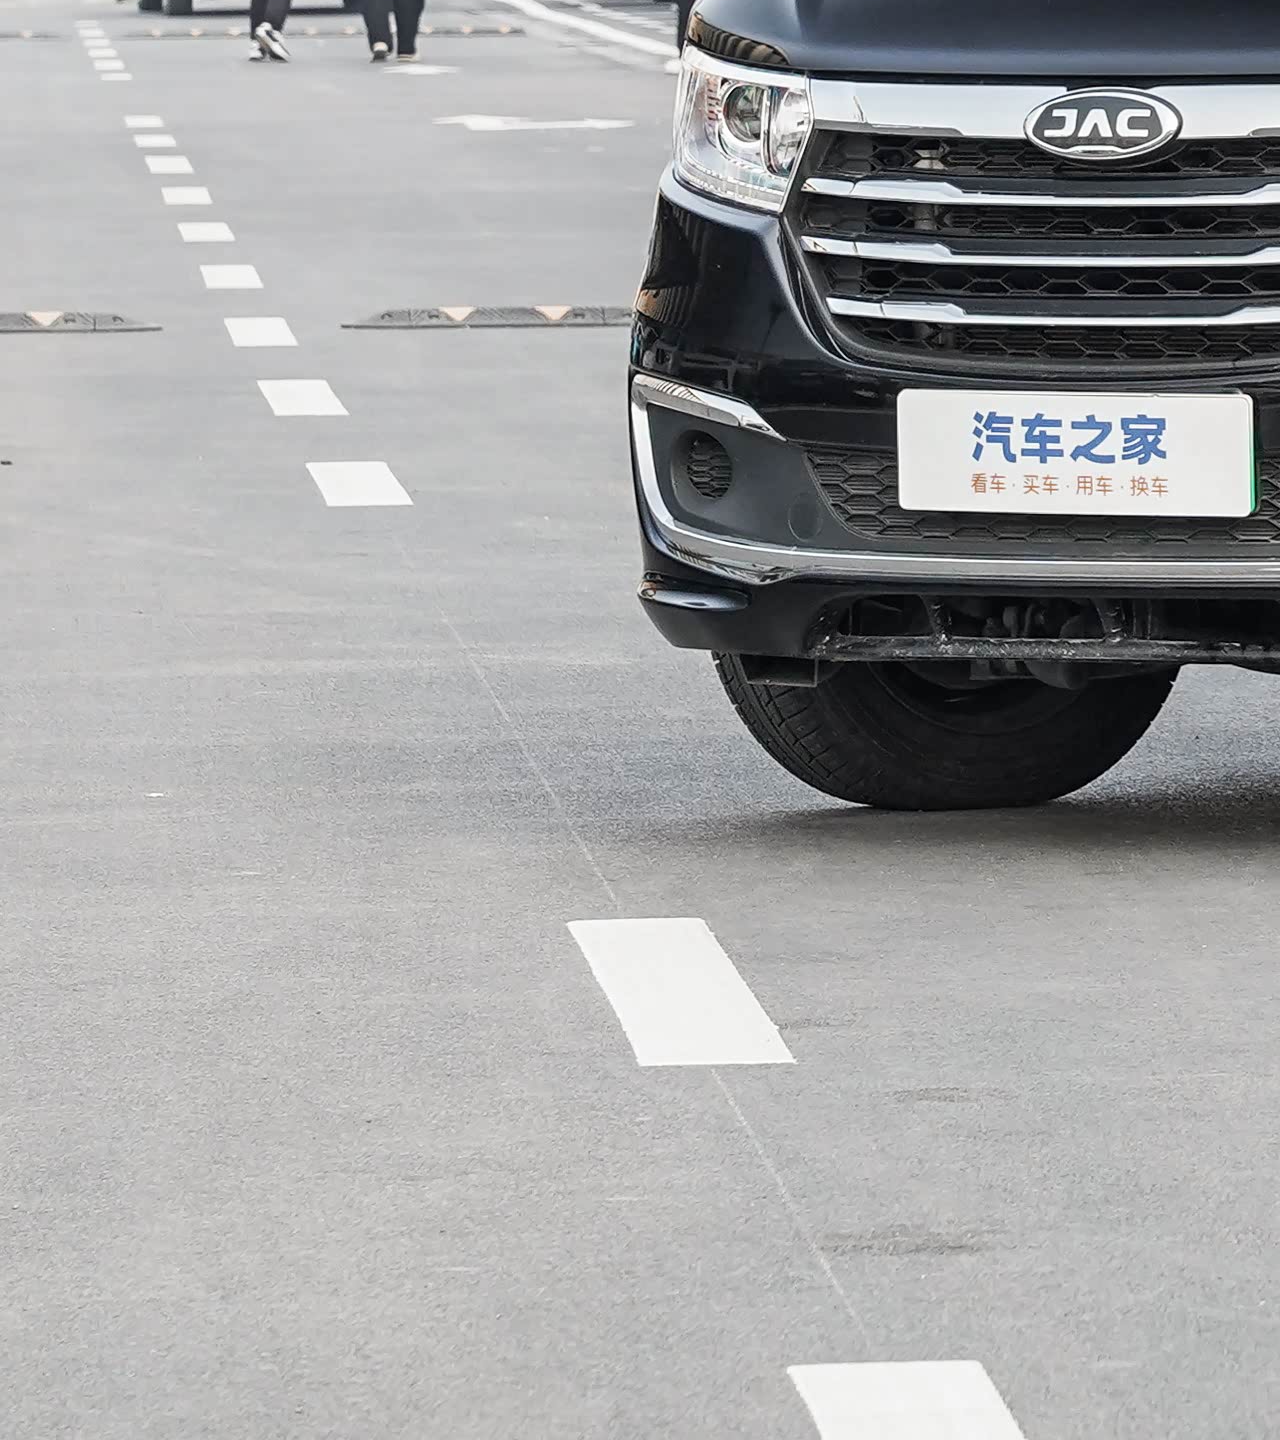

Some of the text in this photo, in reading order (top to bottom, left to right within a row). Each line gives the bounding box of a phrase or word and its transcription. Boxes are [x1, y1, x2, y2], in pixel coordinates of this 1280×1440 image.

[1043, 108, 1152, 138] JAC
[972, 411, 1168, 466] 汽车之家
